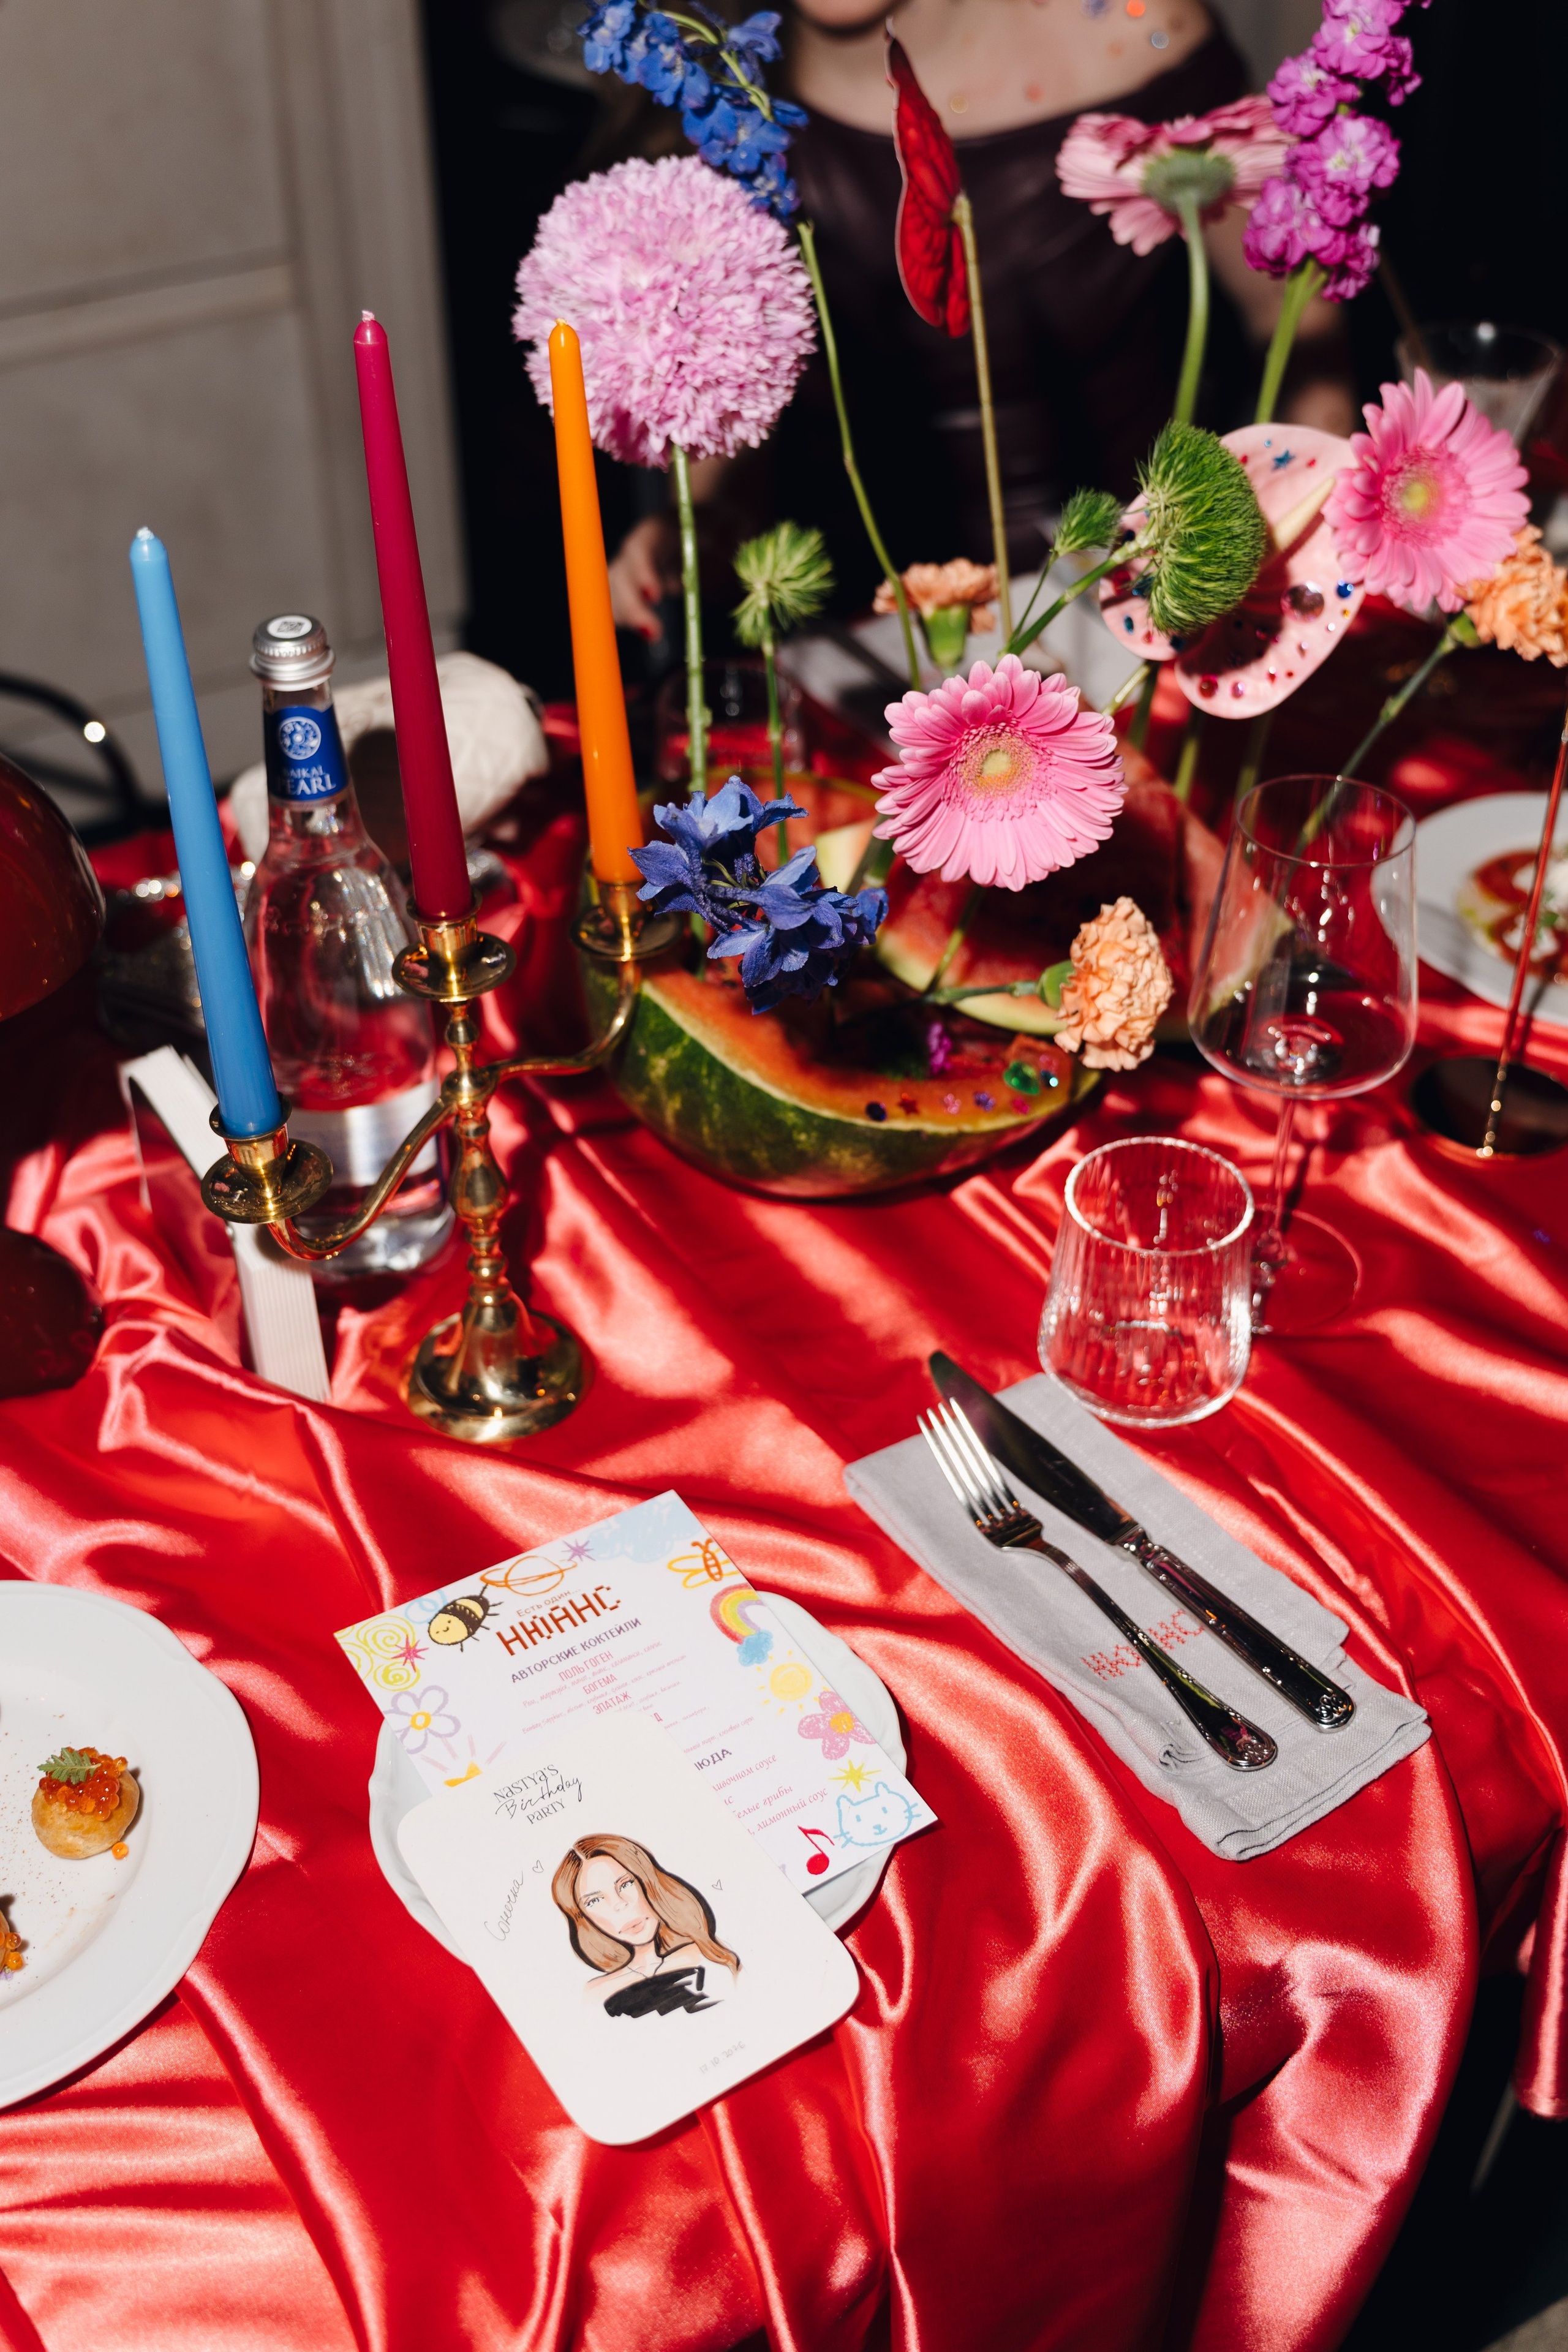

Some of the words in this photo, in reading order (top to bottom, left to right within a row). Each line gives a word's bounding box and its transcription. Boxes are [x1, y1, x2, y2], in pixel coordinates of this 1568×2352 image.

[496, 1585, 621, 1656] НЮАНС
[516, 1604, 543, 1617] Есть
[511, 1645, 580, 1683] АВТОРСКИЕ
[580, 1618, 642, 1651] КОКТЕЙЛИ
[1080, 1608, 1205, 1681] НЮНС
[558, 1664, 585, 1681] ПОЛЬ
[583, 1650, 614, 1670] ГОГЕН
[582, 1673, 618, 1694] БОГЕМА
[593, 1691, 631, 1714] ЭПАТАЖ
[755, 1754, 777, 1770] соусе
[495, 1774, 582, 1820] Birthday
[733, 1801, 761, 1819] елые
[763, 1785, 793, 1806] грибы
[757, 1798, 807, 1831] лимонный
[808, 1787, 828, 1803] соус
